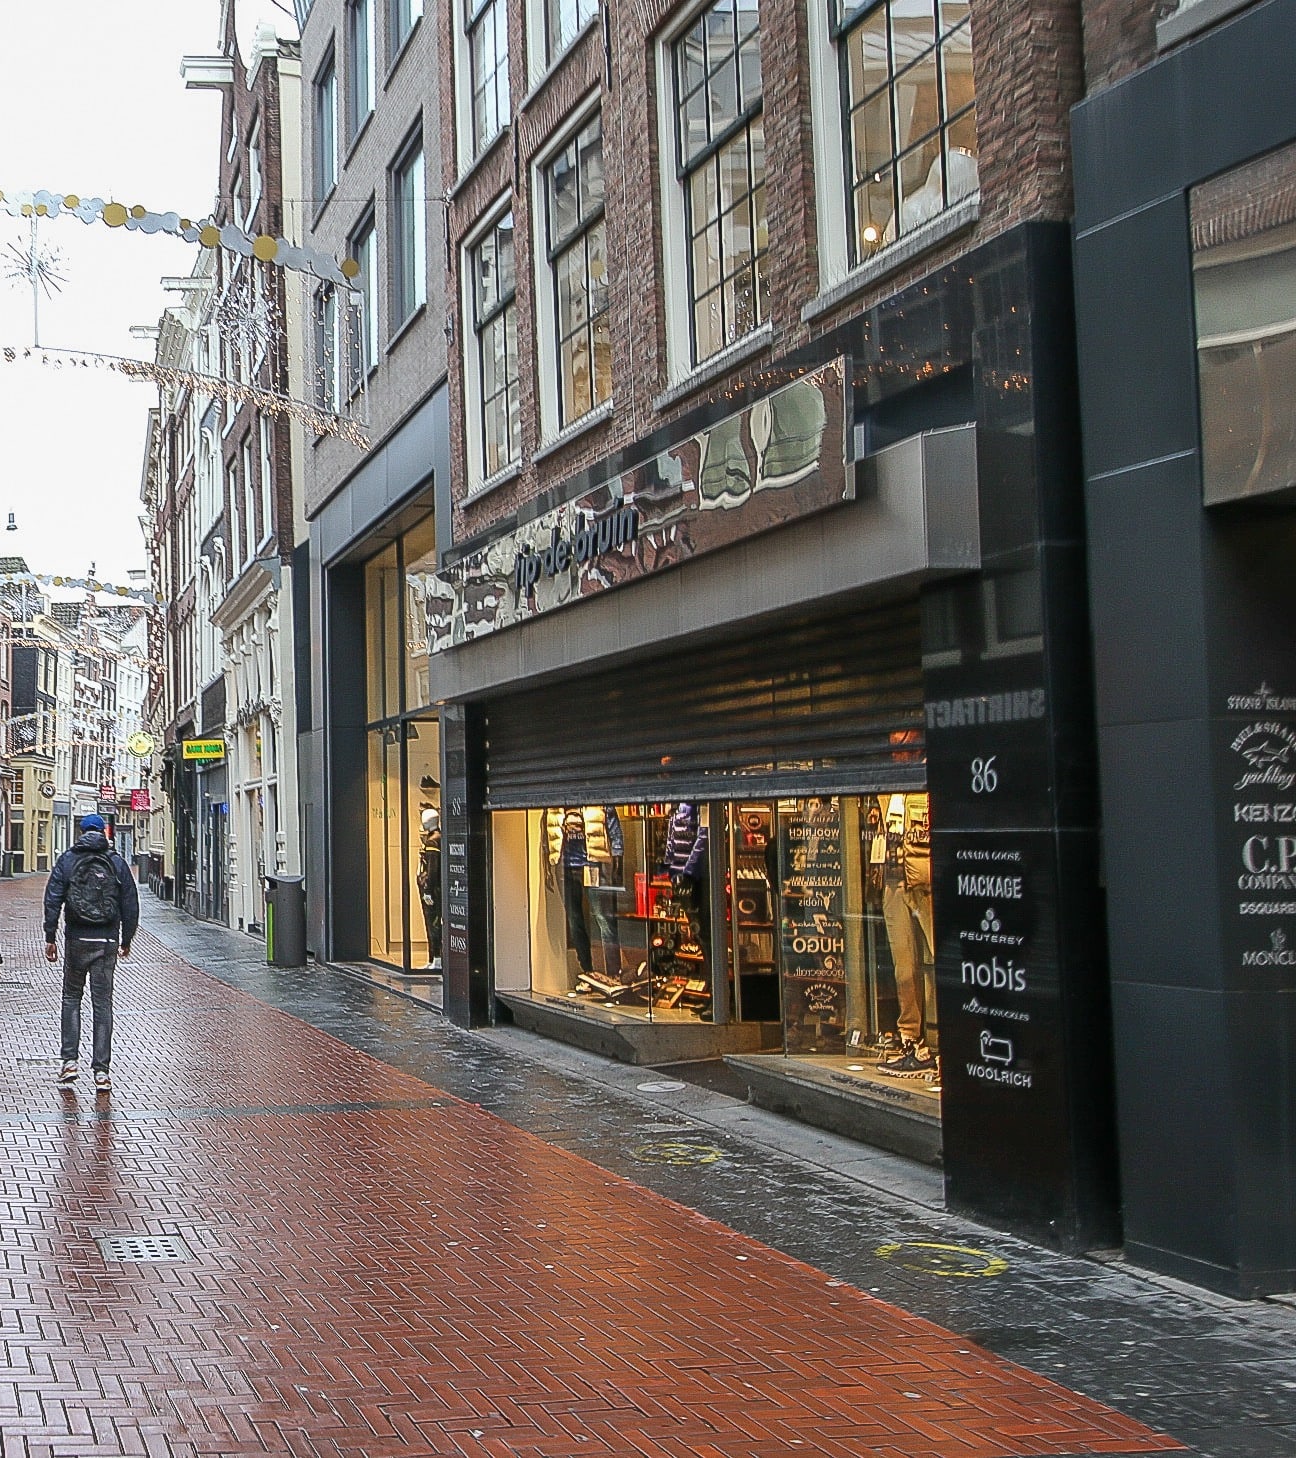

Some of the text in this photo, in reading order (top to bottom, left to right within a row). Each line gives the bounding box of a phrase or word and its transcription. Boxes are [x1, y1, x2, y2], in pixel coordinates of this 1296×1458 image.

[544, 525, 570, 575] de
[575, 497, 637, 563] bruin
[1227, 695, 1263, 710] STONE
[971, 755, 998, 793] 86
[1233, 764, 1296, 791] yachting
[1234, 803, 1296, 822] KENZ
[956, 850, 1021, 861] CANADA GOOSE
[958, 873, 1022, 898] MACKAGE
[451, 935, 466, 949] BOSS
[959, 930, 1024, 945] PEUTEREY
[961, 956, 1026, 991] nobis
[989, 1008, 1030, 1021] KNUCKLES
[966, 1063, 1032, 1088] WOOLRICH
